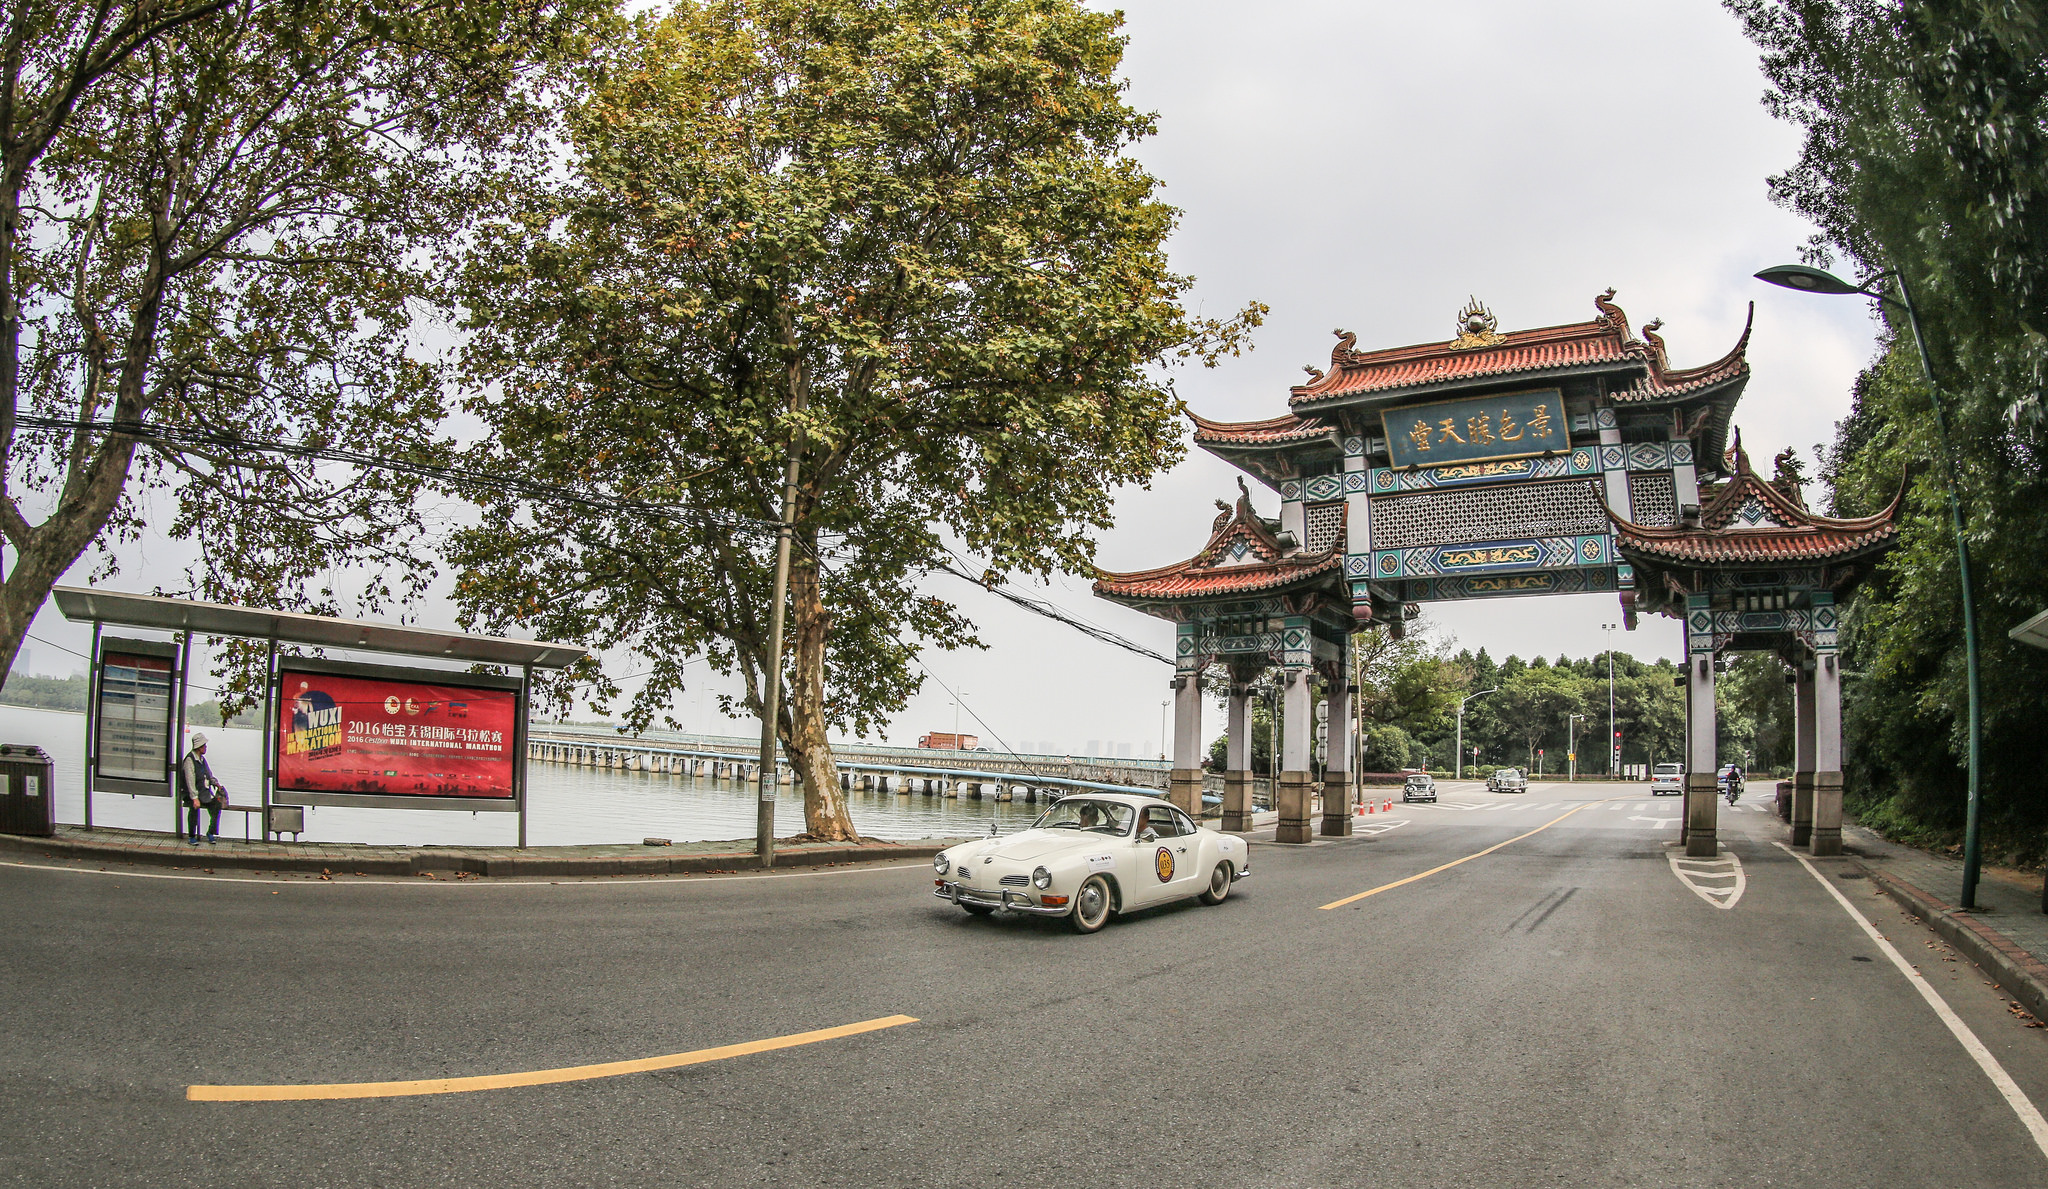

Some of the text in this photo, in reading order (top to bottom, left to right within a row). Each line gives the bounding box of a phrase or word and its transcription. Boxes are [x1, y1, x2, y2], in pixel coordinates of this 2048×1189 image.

[308, 706, 342, 729] WUXI
[347, 720, 380, 736] 2016
[287, 732, 342, 755] MARATHON
[347, 735, 364, 743] 2016
[390, 738, 408, 746] WUXI
[410, 739, 463, 750] INTERNATIONAL
[465, 742, 503, 752] MARATHON
